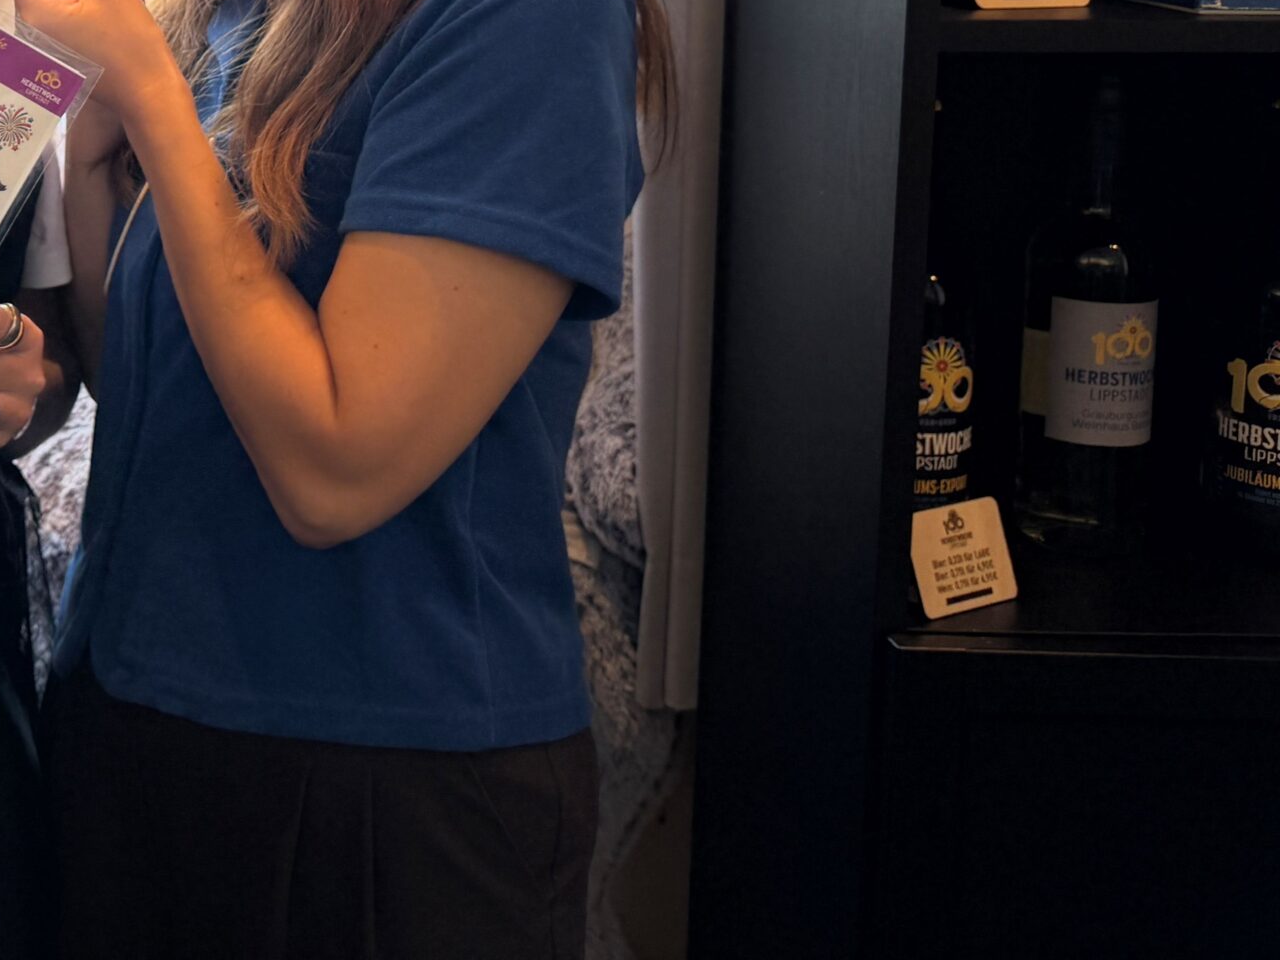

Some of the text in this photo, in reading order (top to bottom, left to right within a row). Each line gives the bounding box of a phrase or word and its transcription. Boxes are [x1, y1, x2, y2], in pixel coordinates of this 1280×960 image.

[20, 77, 62, 105] HERBSTWOCHE
[34, 69, 62, 89] 100
[1090, 330, 1153, 367] 100
